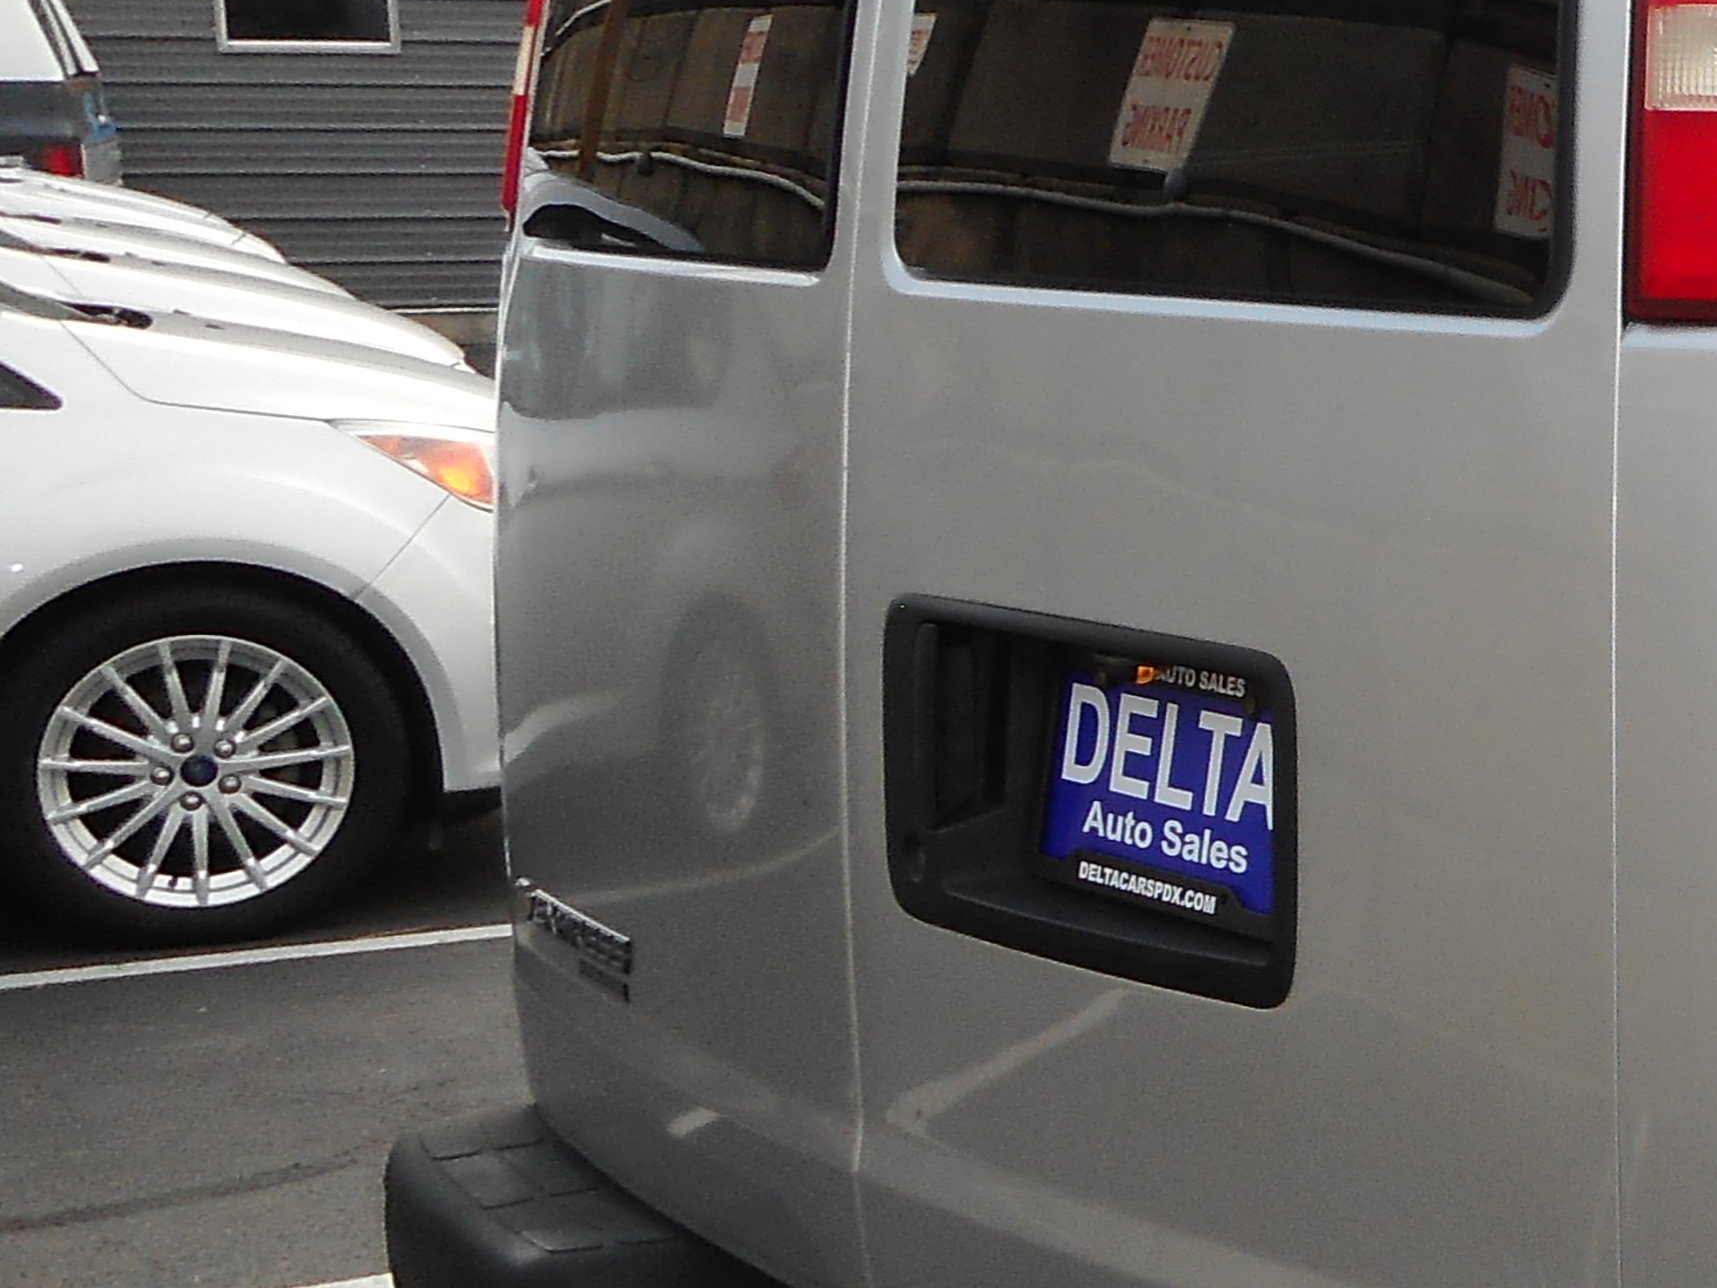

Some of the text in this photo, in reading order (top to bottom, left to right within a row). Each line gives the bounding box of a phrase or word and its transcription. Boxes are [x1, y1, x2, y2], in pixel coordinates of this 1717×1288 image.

[1199, 671, 1246, 698] SALES
[1060, 682, 1274, 831] DELTA
[1082, 800, 1249, 874] Auto Sales
[1078, 860, 1217, 915] DELTACARSPDX.COM
